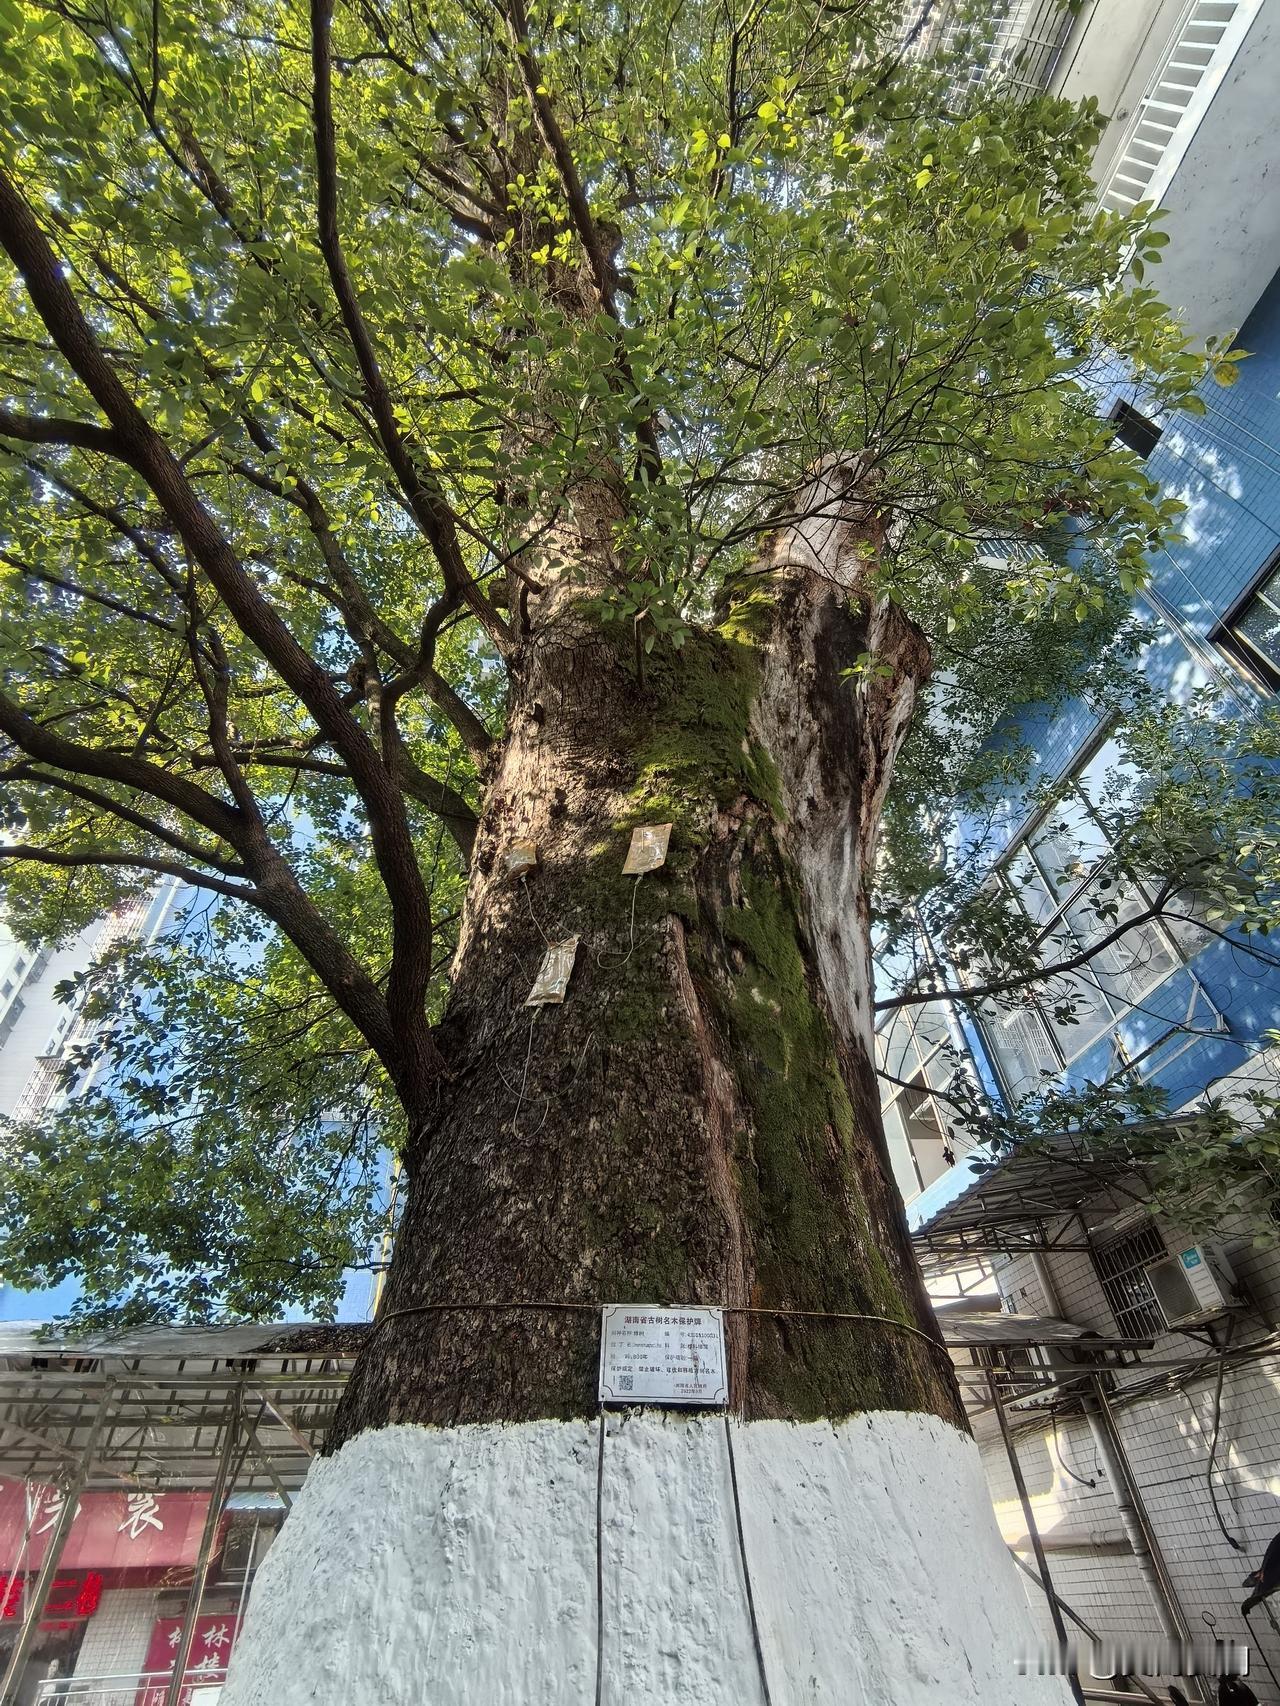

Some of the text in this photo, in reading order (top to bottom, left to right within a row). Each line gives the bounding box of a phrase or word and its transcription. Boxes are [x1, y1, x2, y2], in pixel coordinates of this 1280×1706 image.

[624, 1315, 702, 1326] 湖南省古树名木保护牌
